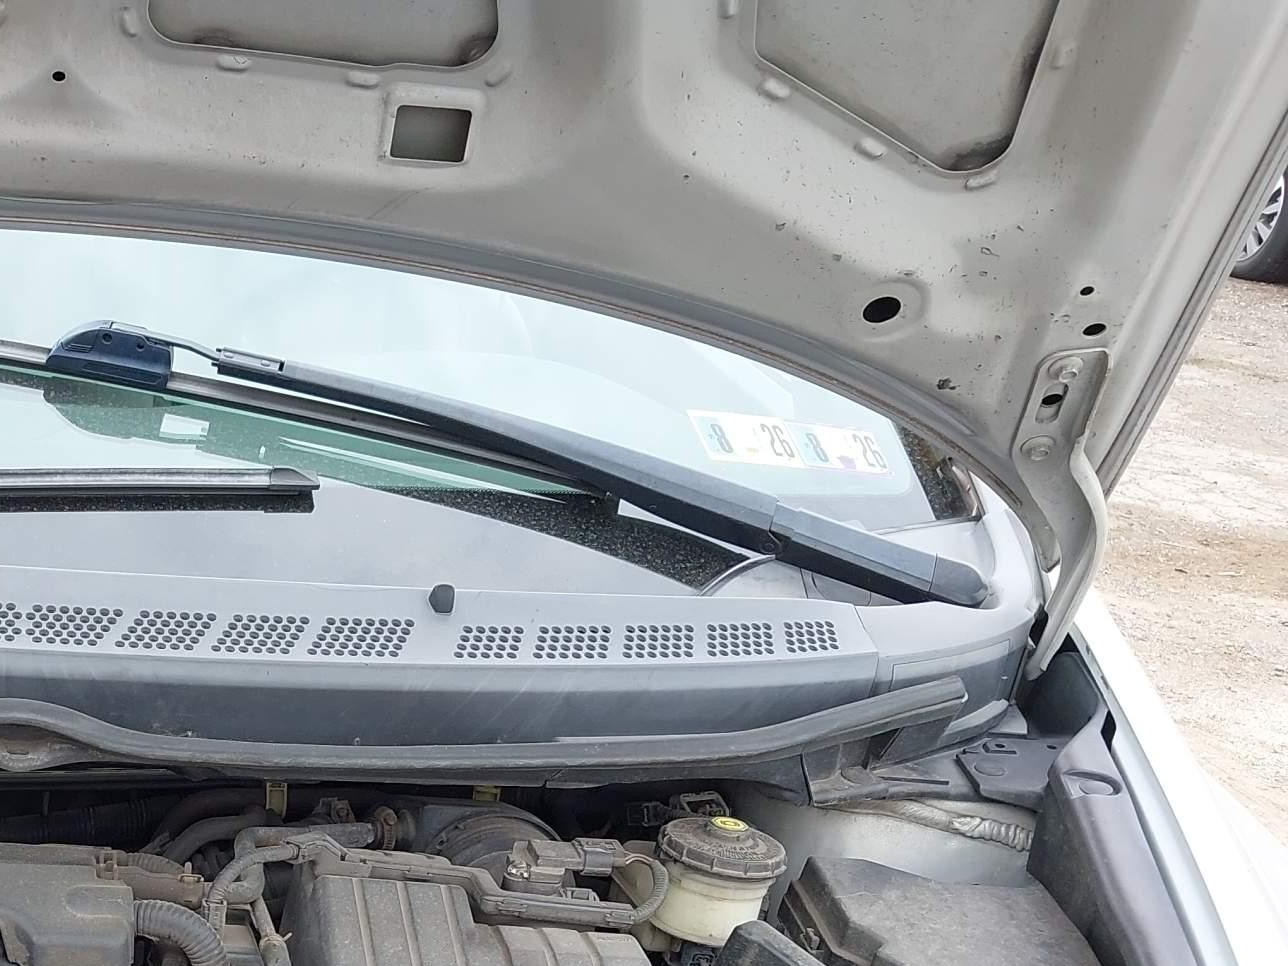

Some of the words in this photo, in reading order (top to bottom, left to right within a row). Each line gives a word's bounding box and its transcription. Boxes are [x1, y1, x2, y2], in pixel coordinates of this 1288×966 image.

[709, 423, 734, 453] 8
[759, 423, 796, 458] 26
[804, 432, 830, 463] 8
[851, 433, 888, 469] 26
